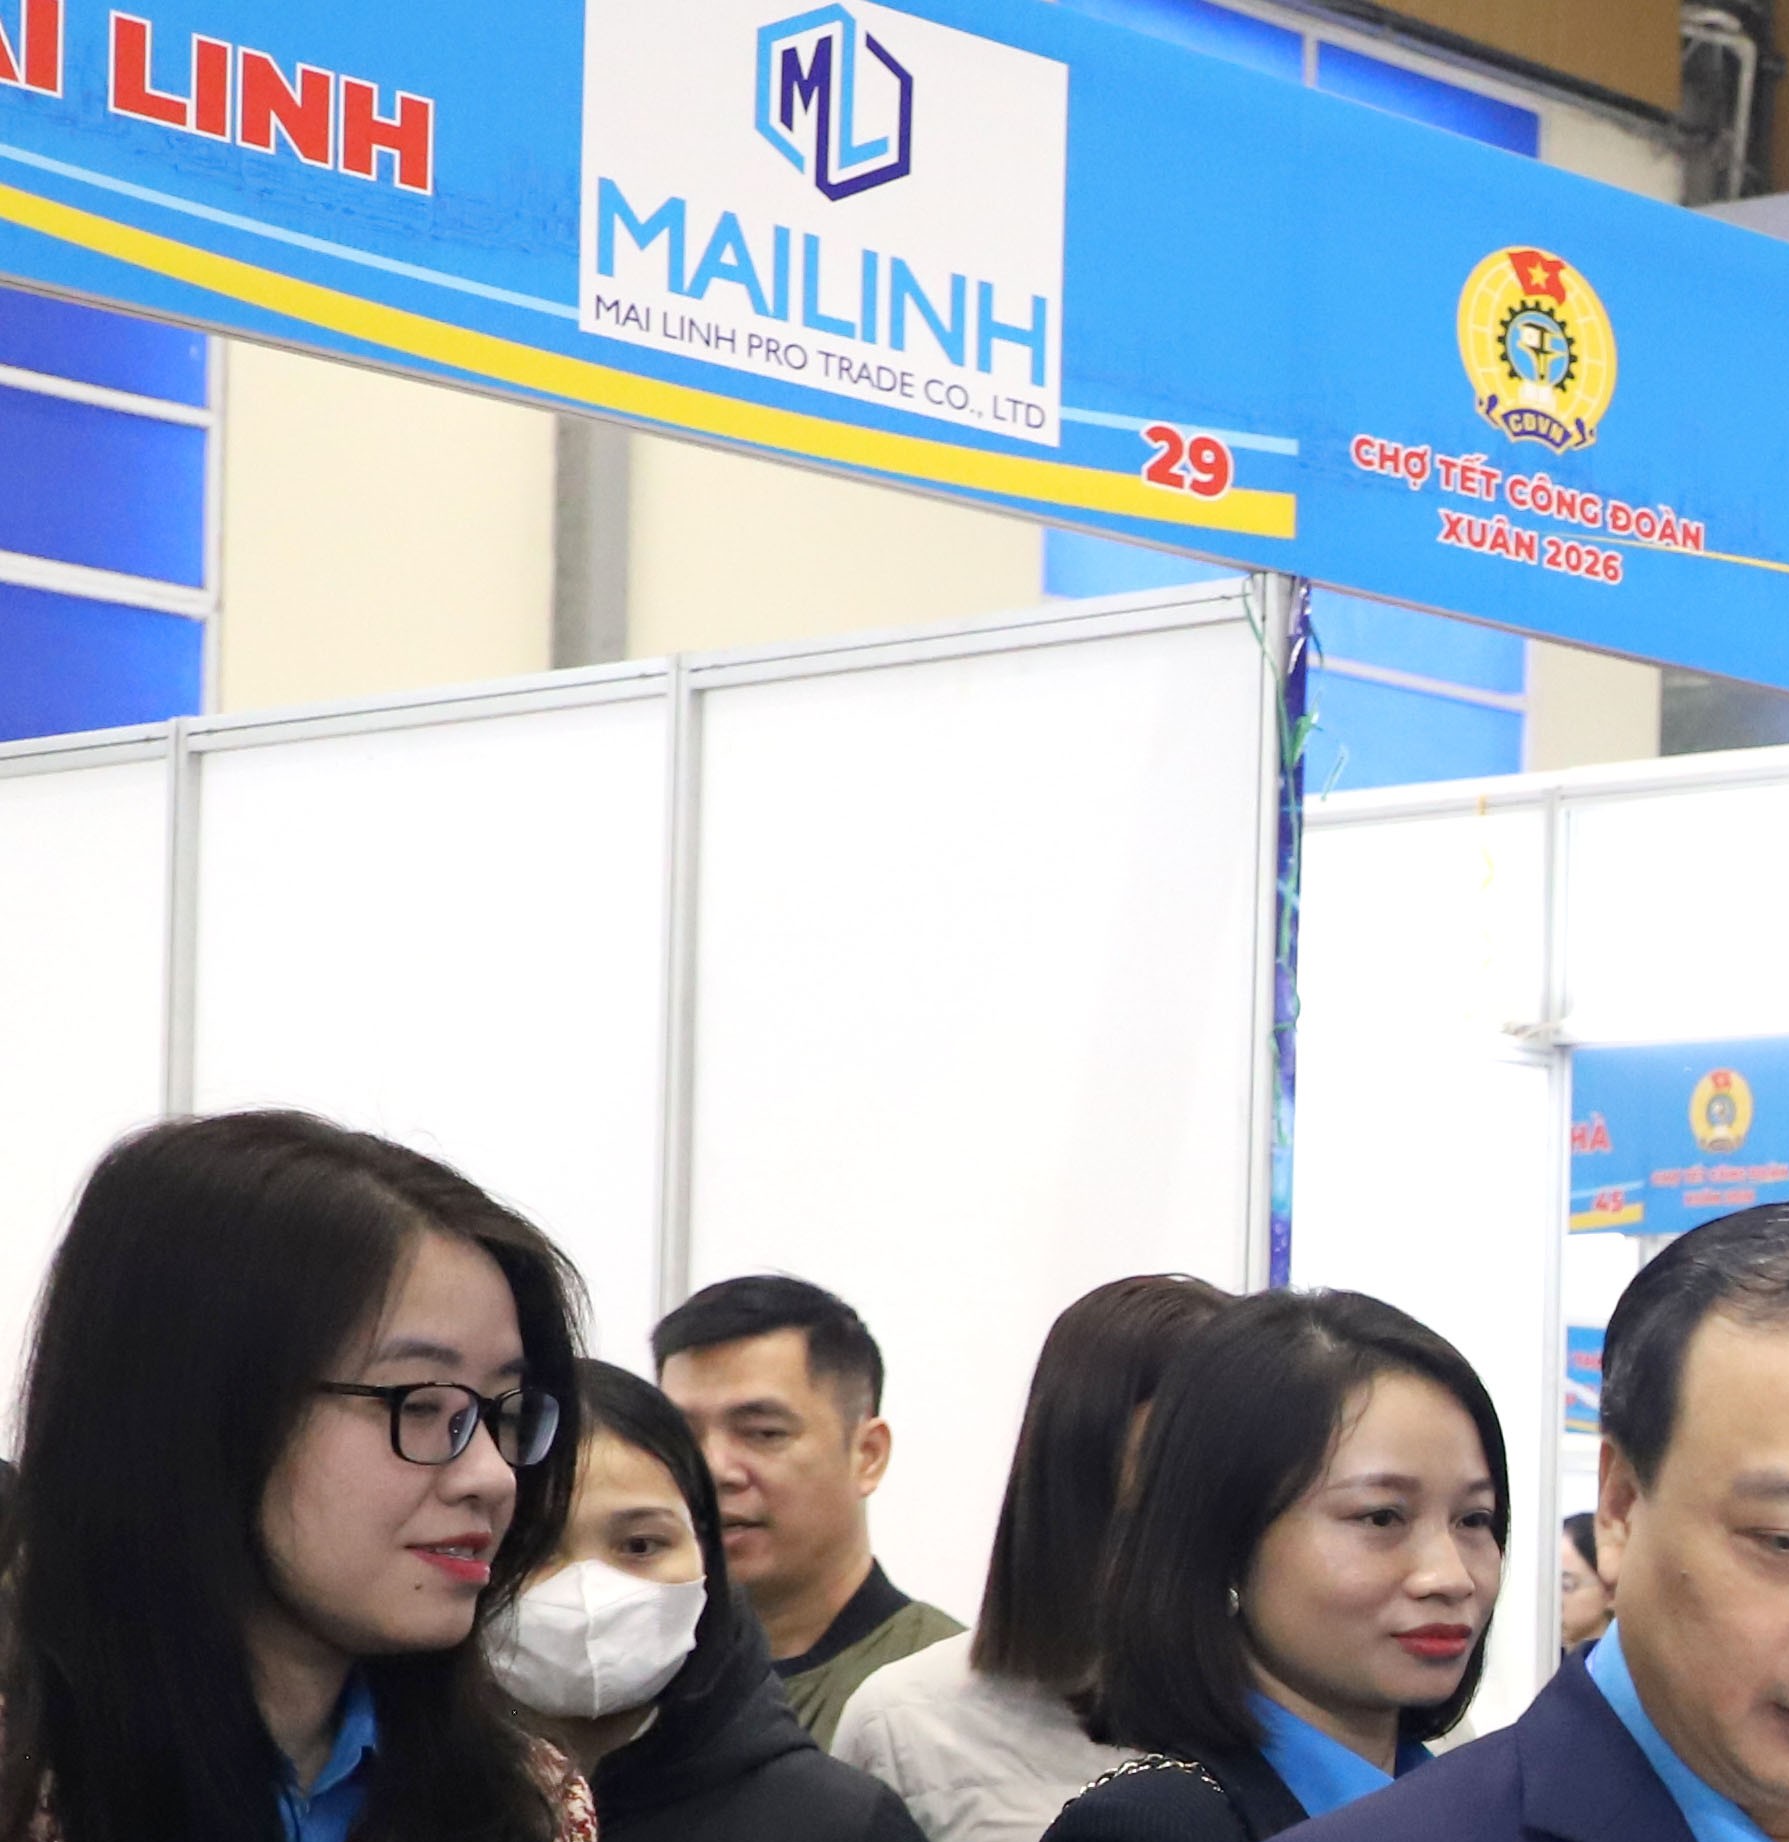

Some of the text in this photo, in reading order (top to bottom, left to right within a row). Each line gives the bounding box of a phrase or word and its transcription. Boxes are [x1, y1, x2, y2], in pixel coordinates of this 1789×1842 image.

[108, 9, 434, 195] LINH
[597, 176, 1047, 388] MAILINH
[594, 294, 651, 332] MAI
[662, 311, 737, 355] LINH
[747, 333, 808, 370] PRO
[818, 350, 915, 398] TRADE
[992, 397, 1046, 430] LTD
[1141, 425, 1233, 498] 29
[1351, 434, 1705, 553] CHỢ TẾT CÔNG ĐOÀN
[1438, 509, 1623, 585] XUÂN 2026
